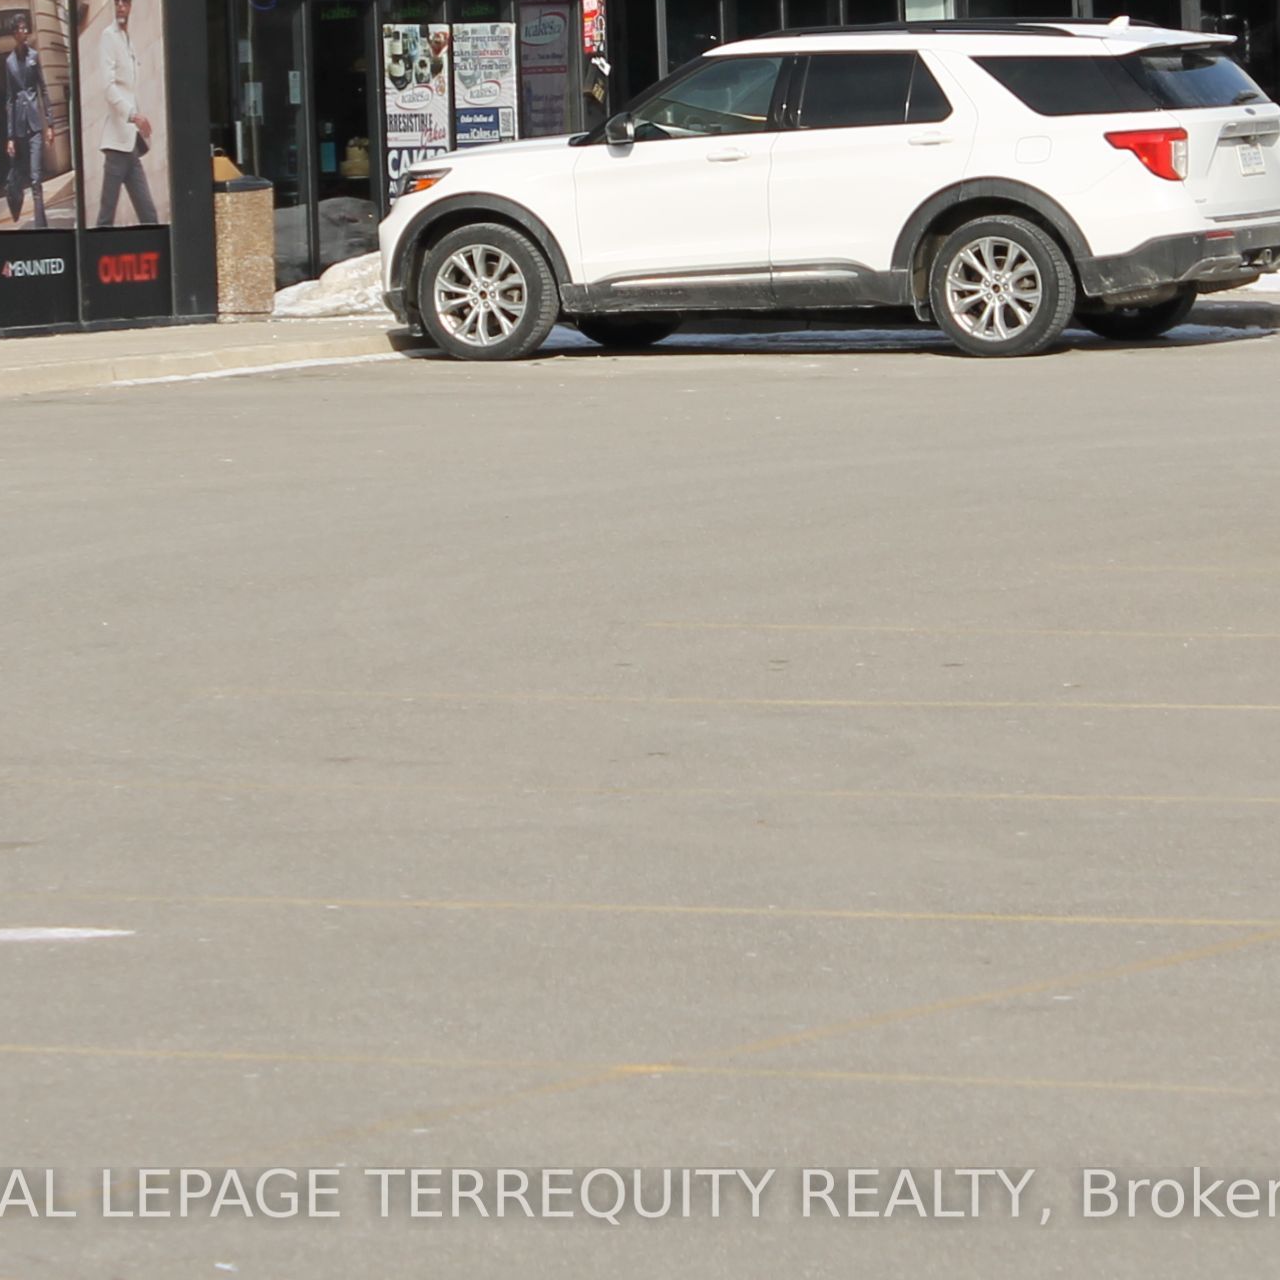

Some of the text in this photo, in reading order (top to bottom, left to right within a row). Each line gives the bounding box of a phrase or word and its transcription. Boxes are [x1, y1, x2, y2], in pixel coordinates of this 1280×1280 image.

[388, 113, 433, 132] IRRESISTIBLE
[1, 258, 64, 277] 4MENUNITED
[98, 252, 159, 283] OUTLET
